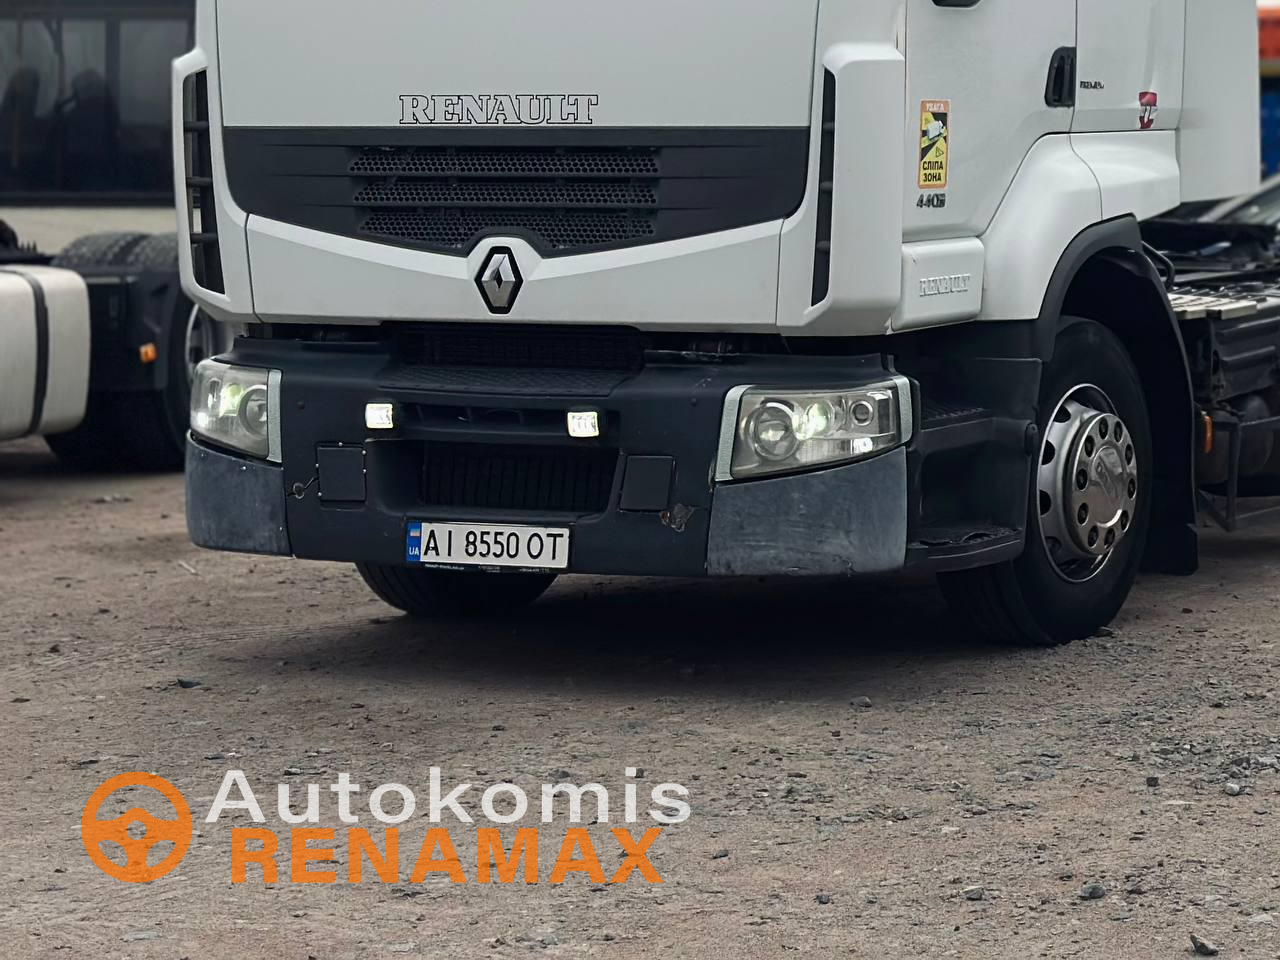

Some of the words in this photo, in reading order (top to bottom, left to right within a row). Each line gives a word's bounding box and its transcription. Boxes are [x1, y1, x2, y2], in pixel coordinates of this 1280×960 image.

[399, 94, 599, 125] RENAULT
[922, 161, 944, 171] СЛІПА
[923, 172, 942, 182] ЗОНА
[919, 274, 970, 297] RENAULT
[409, 547, 420, 556] UA
[423, 529, 452, 557] AI
[464, 530, 519, 559] 8550
[526, 532, 564, 560] OT
